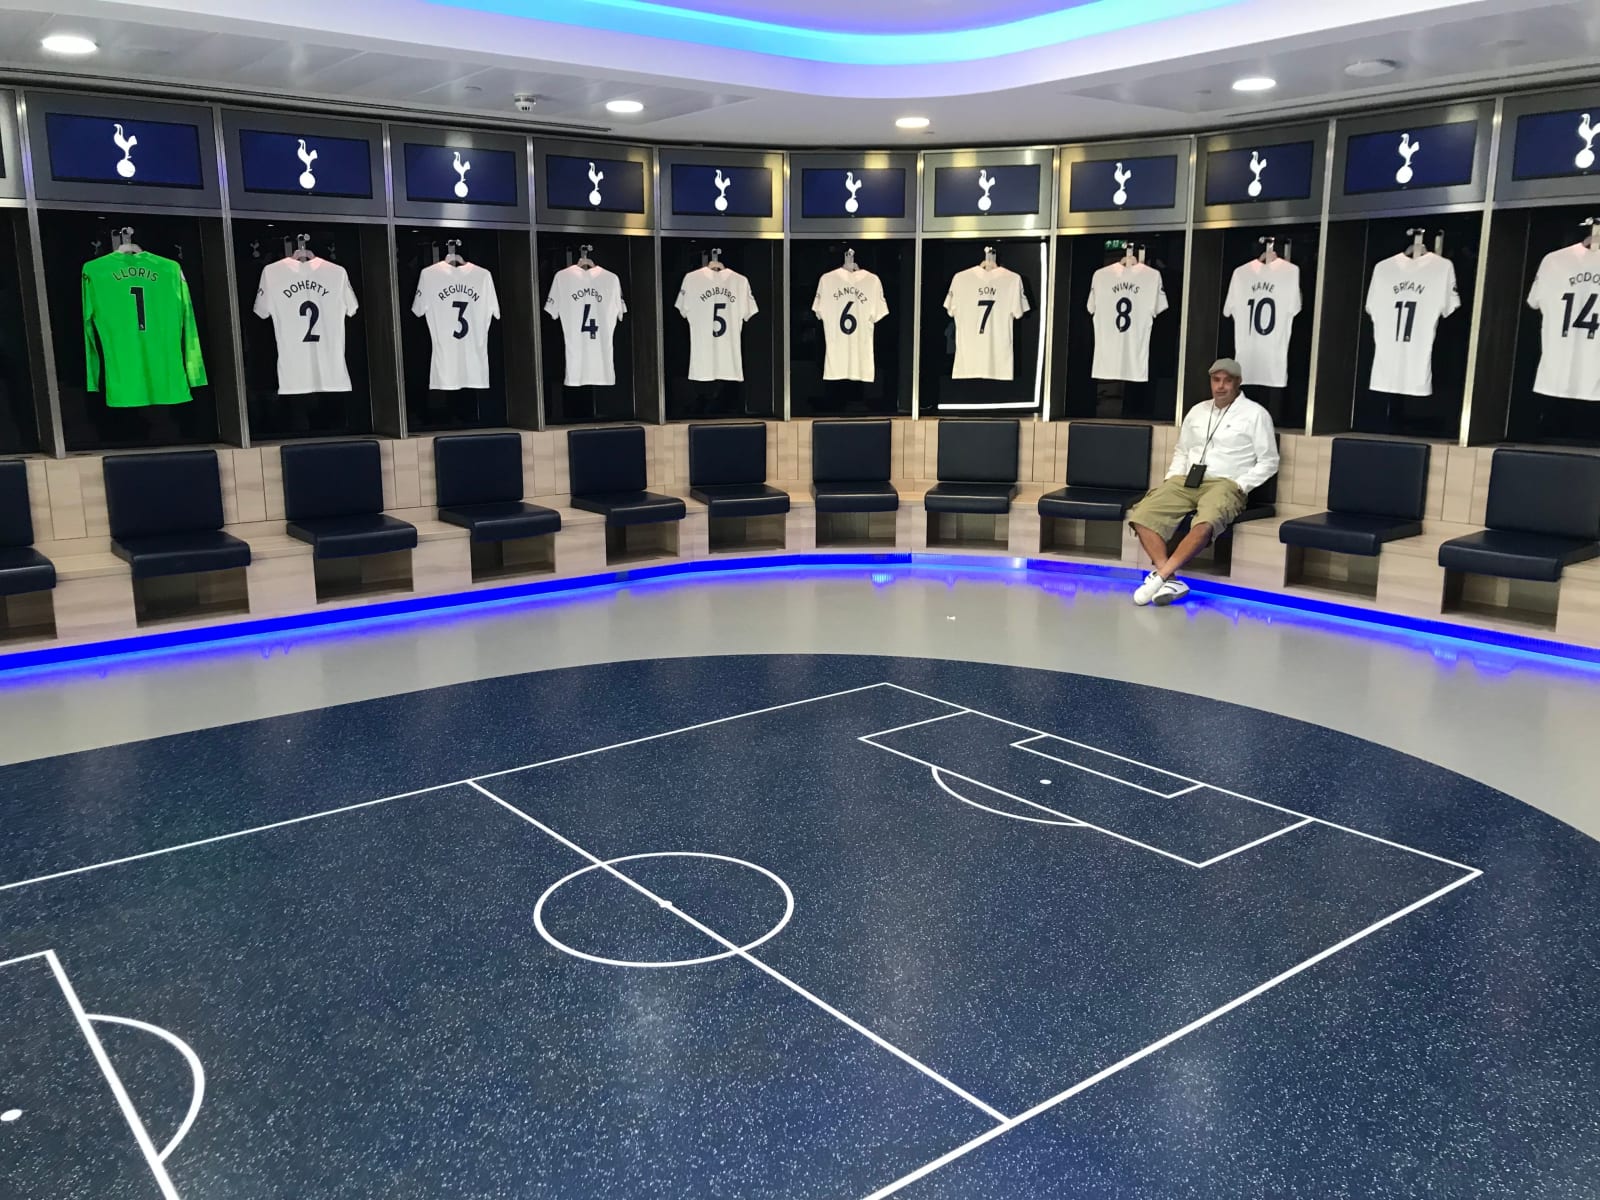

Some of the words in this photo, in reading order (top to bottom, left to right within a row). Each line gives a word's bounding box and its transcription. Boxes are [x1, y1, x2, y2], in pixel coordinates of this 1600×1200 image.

[112, 266, 159, 282] LLORIS
[282, 279, 330, 299] DOHERTY
[978, 287, 997, 296] SON
[1111, 281, 1140, 295] WINKS
[1251, 281, 1275, 293] KANE
[1569, 271, 1600, 287] RODO
[130, 286, 146, 331] 1
[571, 288, 603, 303] ROMERO
[699, 286, 736, 303] HØJBJERG
[299, 300, 321, 343] 2
[451, 300, 469, 340] 3
[581, 303, 599, 339] 4
[712, 303, 727, 338] 5
[839, 301, 858, 335] 6
[977, 300, 996, 335] 7
[1115, 297, 1133, 333] 8
[1247, 297, 1276, 336] 10
[1394, 300, 1417, 343] 11
[1561, 292, 1600, 340] 14
